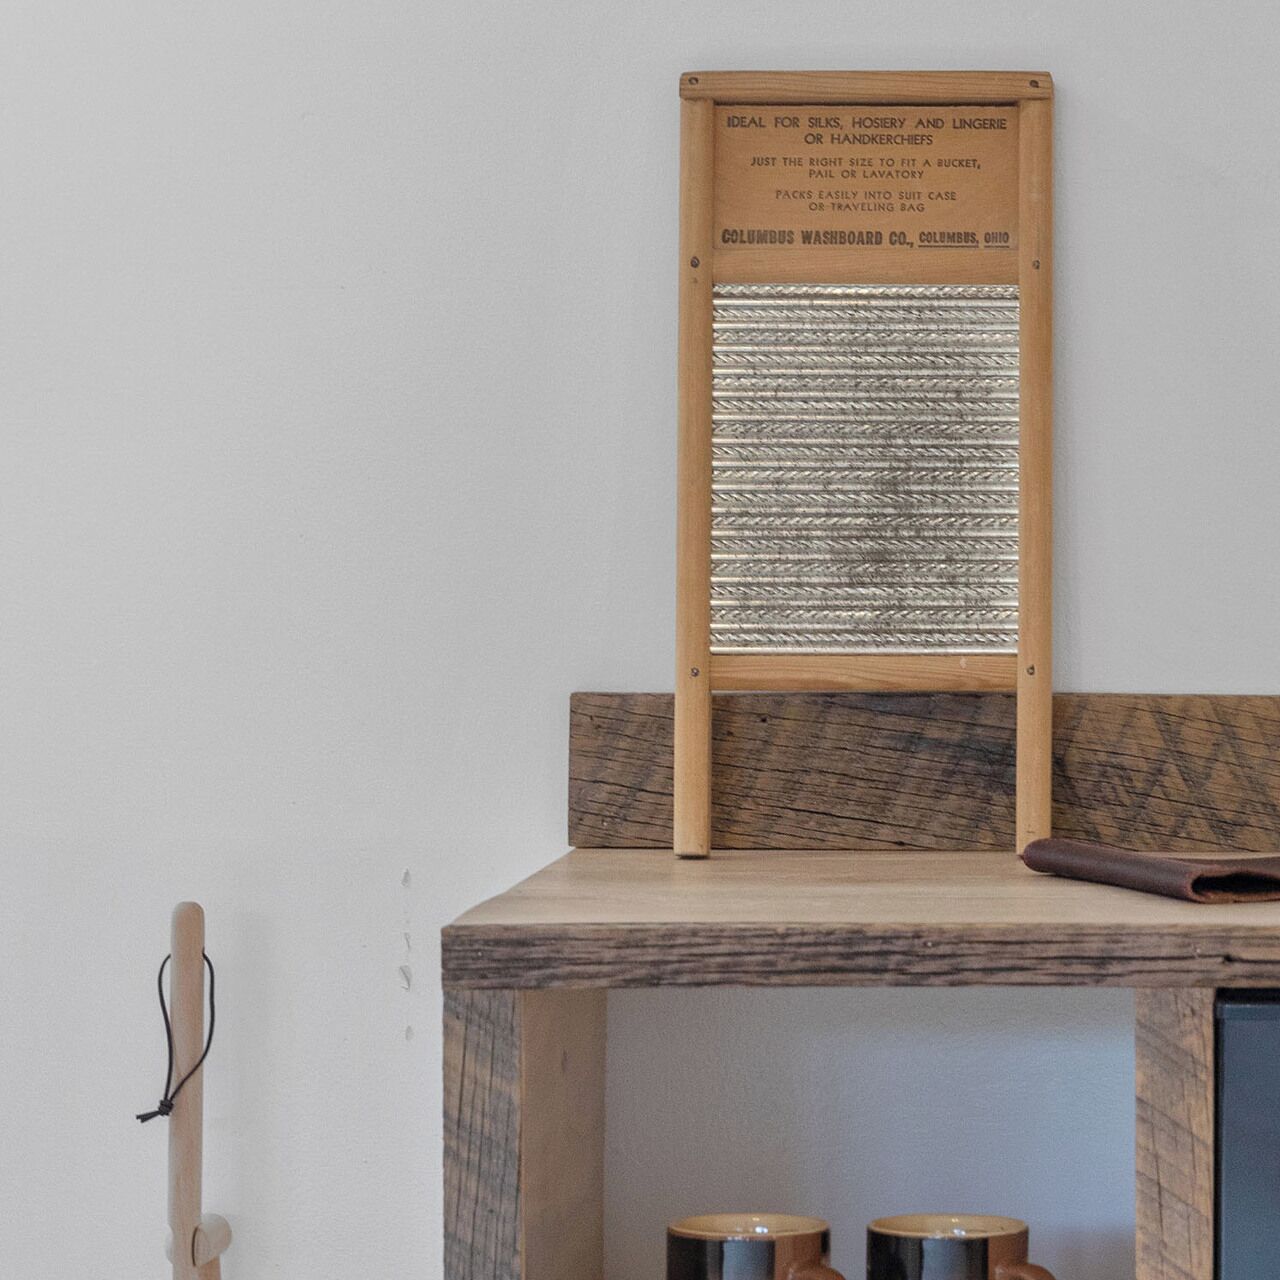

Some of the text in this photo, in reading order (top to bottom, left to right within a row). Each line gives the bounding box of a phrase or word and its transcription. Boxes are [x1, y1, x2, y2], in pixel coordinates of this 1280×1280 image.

[726, 116, 1007, 131] IDEAL FOR SILKS, HOSIERY AND LINGERIE
[804, 133, 933, 146] OR HANDKERCHIEFS
[750, 157, 981, 170] JUST THE RIGHT SIZE TO FIT A BUCKET,
[809, 170, 924, 179] PAIL OR LAVATORY
[775, 190, 957, 201] PACKS EASILY INTO SUIT CASE
[809, 203, 925, 212] OR TRAVELING BAG
[721, 228, 1009, 248] COLUMBUS WASHBOARD CO., COLUMBUS, OHIO
